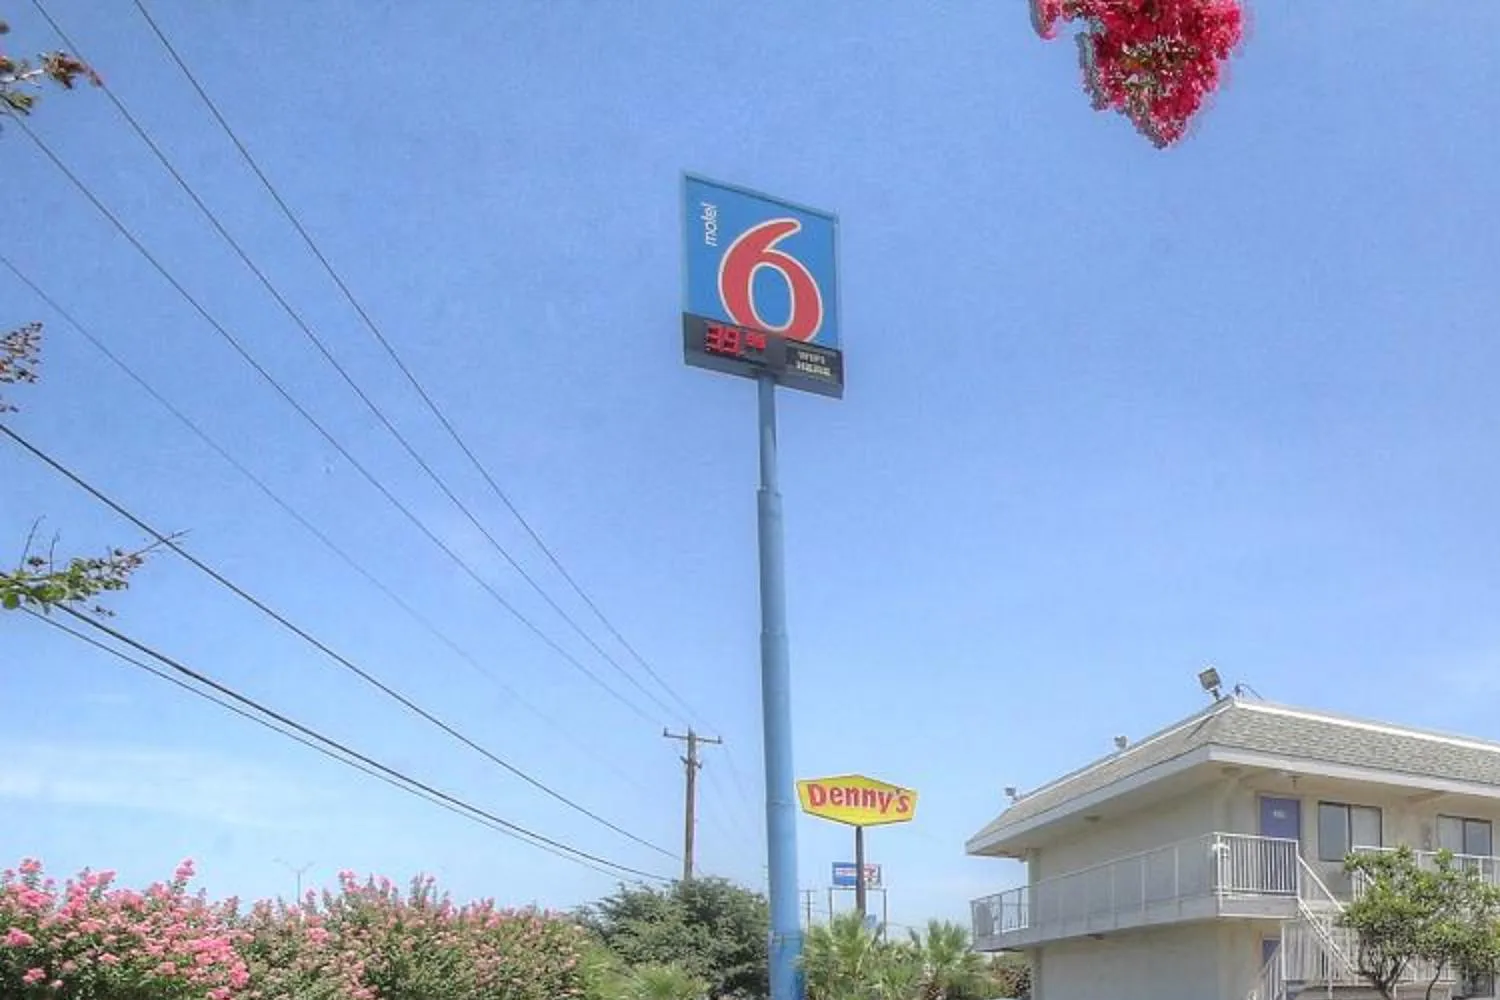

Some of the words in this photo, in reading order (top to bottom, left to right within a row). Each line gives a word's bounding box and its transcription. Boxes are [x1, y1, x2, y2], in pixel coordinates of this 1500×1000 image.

[701, 202, 717, 247] motel
[718, 217, 823, 342] 6
[807, 783, 911, 814] Denny's
